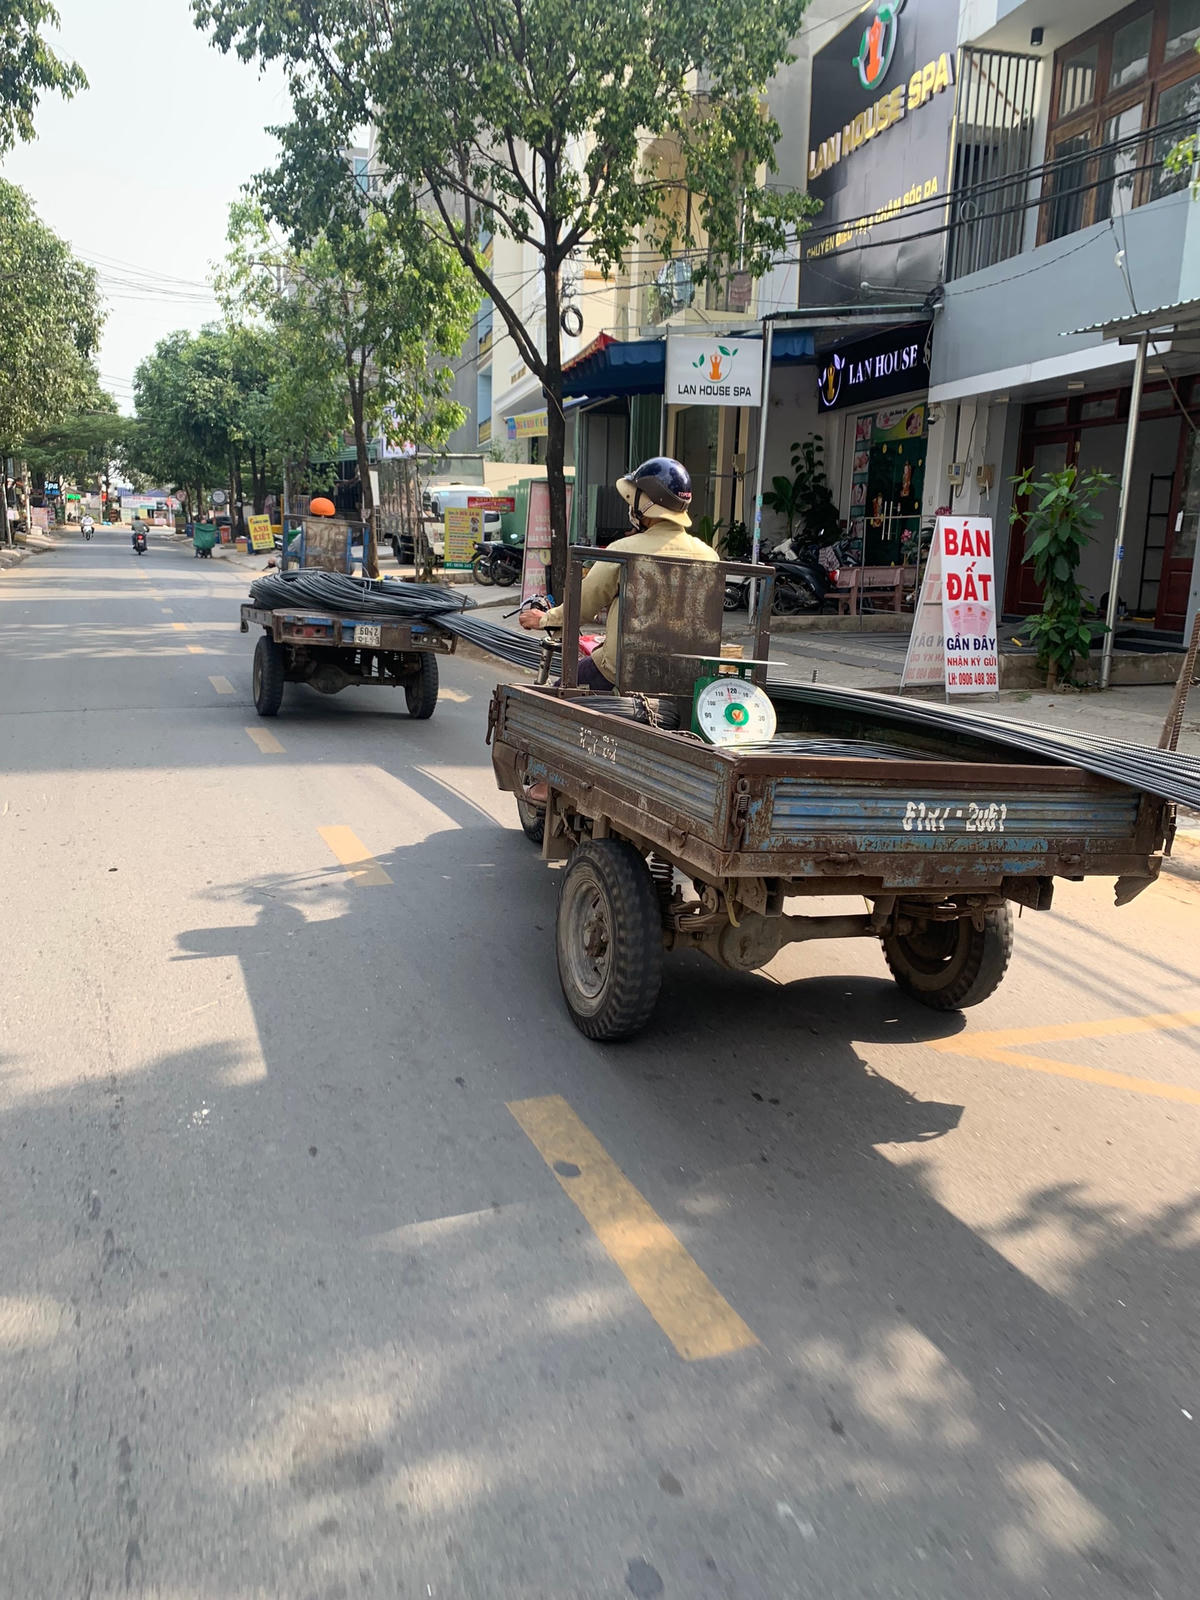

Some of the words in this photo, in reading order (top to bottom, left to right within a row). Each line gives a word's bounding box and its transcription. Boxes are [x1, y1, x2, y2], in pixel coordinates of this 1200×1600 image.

[808, 131, 842, 180] LAN
[841, 84, 906, 157] HOUSE
[907, 52, 954, 111] SPA
[923, 176, 938, 198] DA
[848, 358, 873, 385] LAN
[874, 344, 918, 378] HOUSE
[678, 384, 697, 395] LAN
[699, 385, 731, 396] HOUSE
[733, 386, 752, 397] SPA
[944, 520, 991, 557] BÁN
[946, 561, 992, 601] ĐẤT
[947, 632, 969, 651] GẦN
[973, 634, 996, 651] ĐÂY
[947, 655, 969, 668] NHẬN
[971, 655, 981, 666] KÝ
[983, 654, 997, 667] GỬI
[948, 672, 957, 685] LH:
[958, 672, 973, 686] 0906
[986, 672, 997, 686] 366
